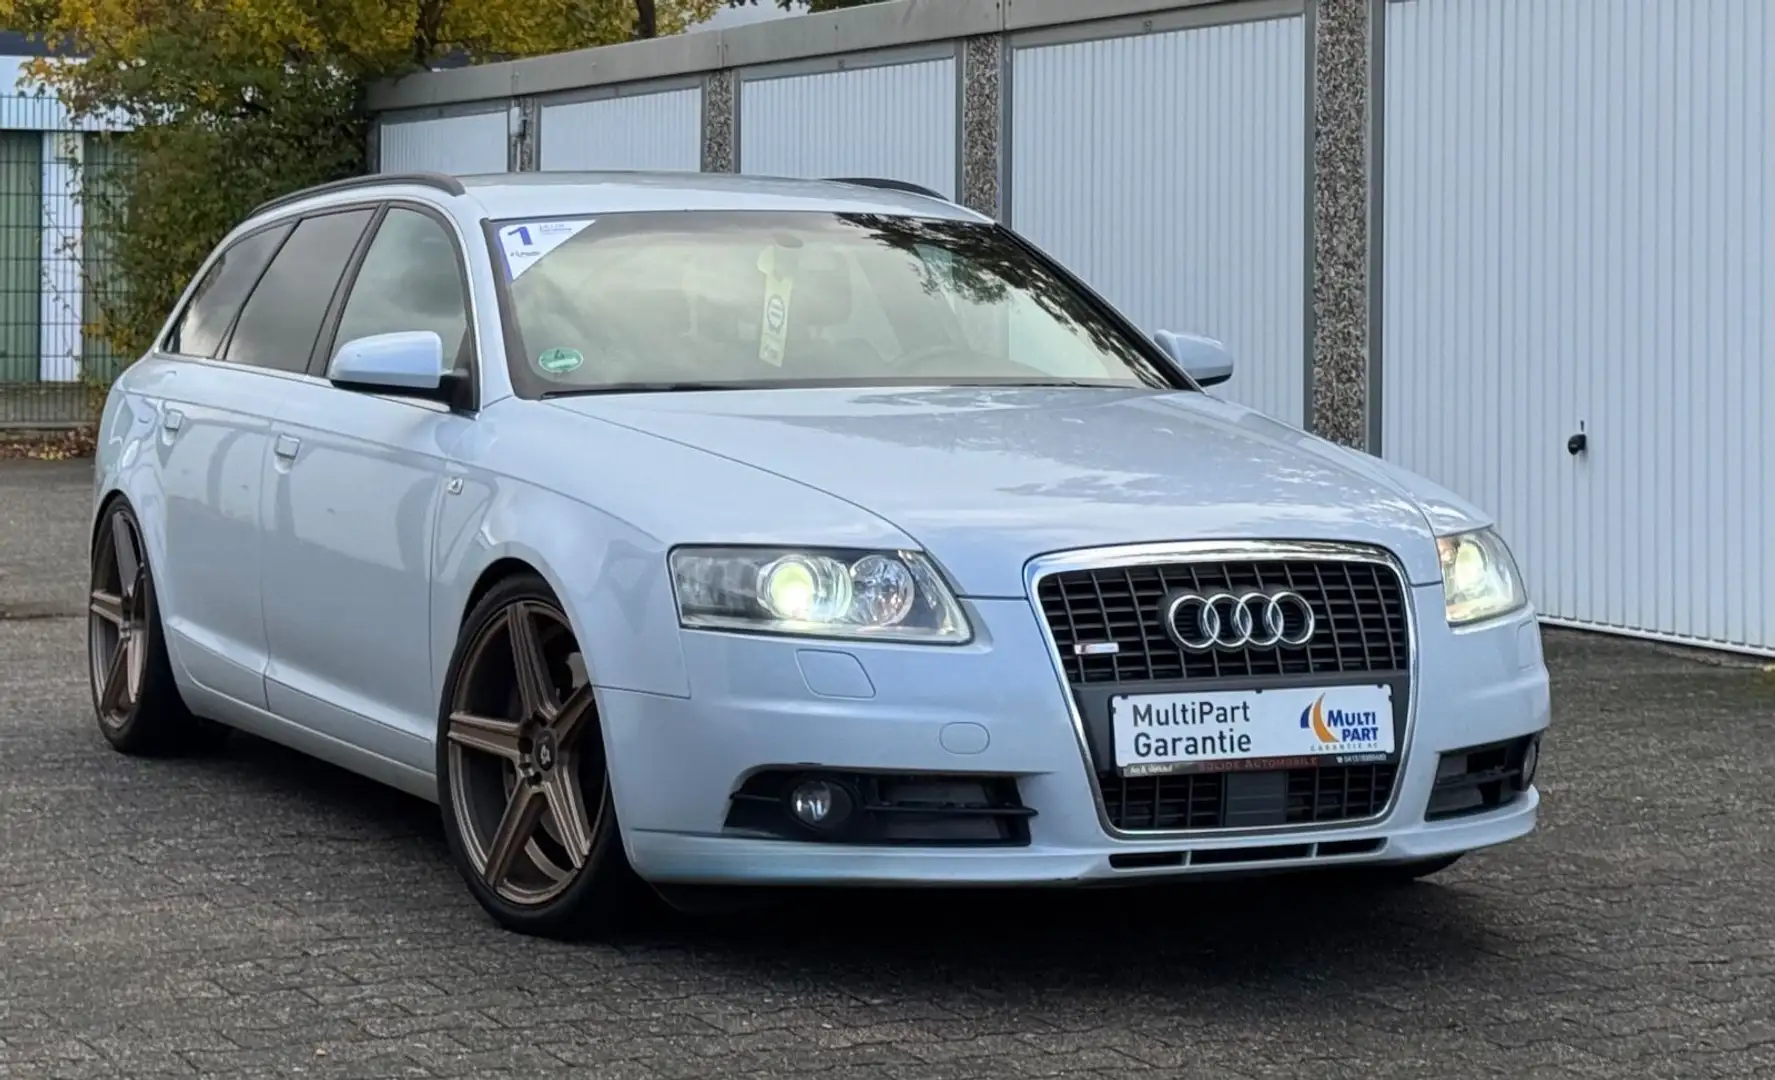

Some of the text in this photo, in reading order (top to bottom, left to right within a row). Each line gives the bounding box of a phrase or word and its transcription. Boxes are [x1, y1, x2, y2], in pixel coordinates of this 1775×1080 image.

[1132, 701, 1250, 727] MultiPart
[1327, 710, 1376, 727] MULTI
[1134, 728, 1252, 757] Garantie
[1342, 727, 1379, 742] PART
